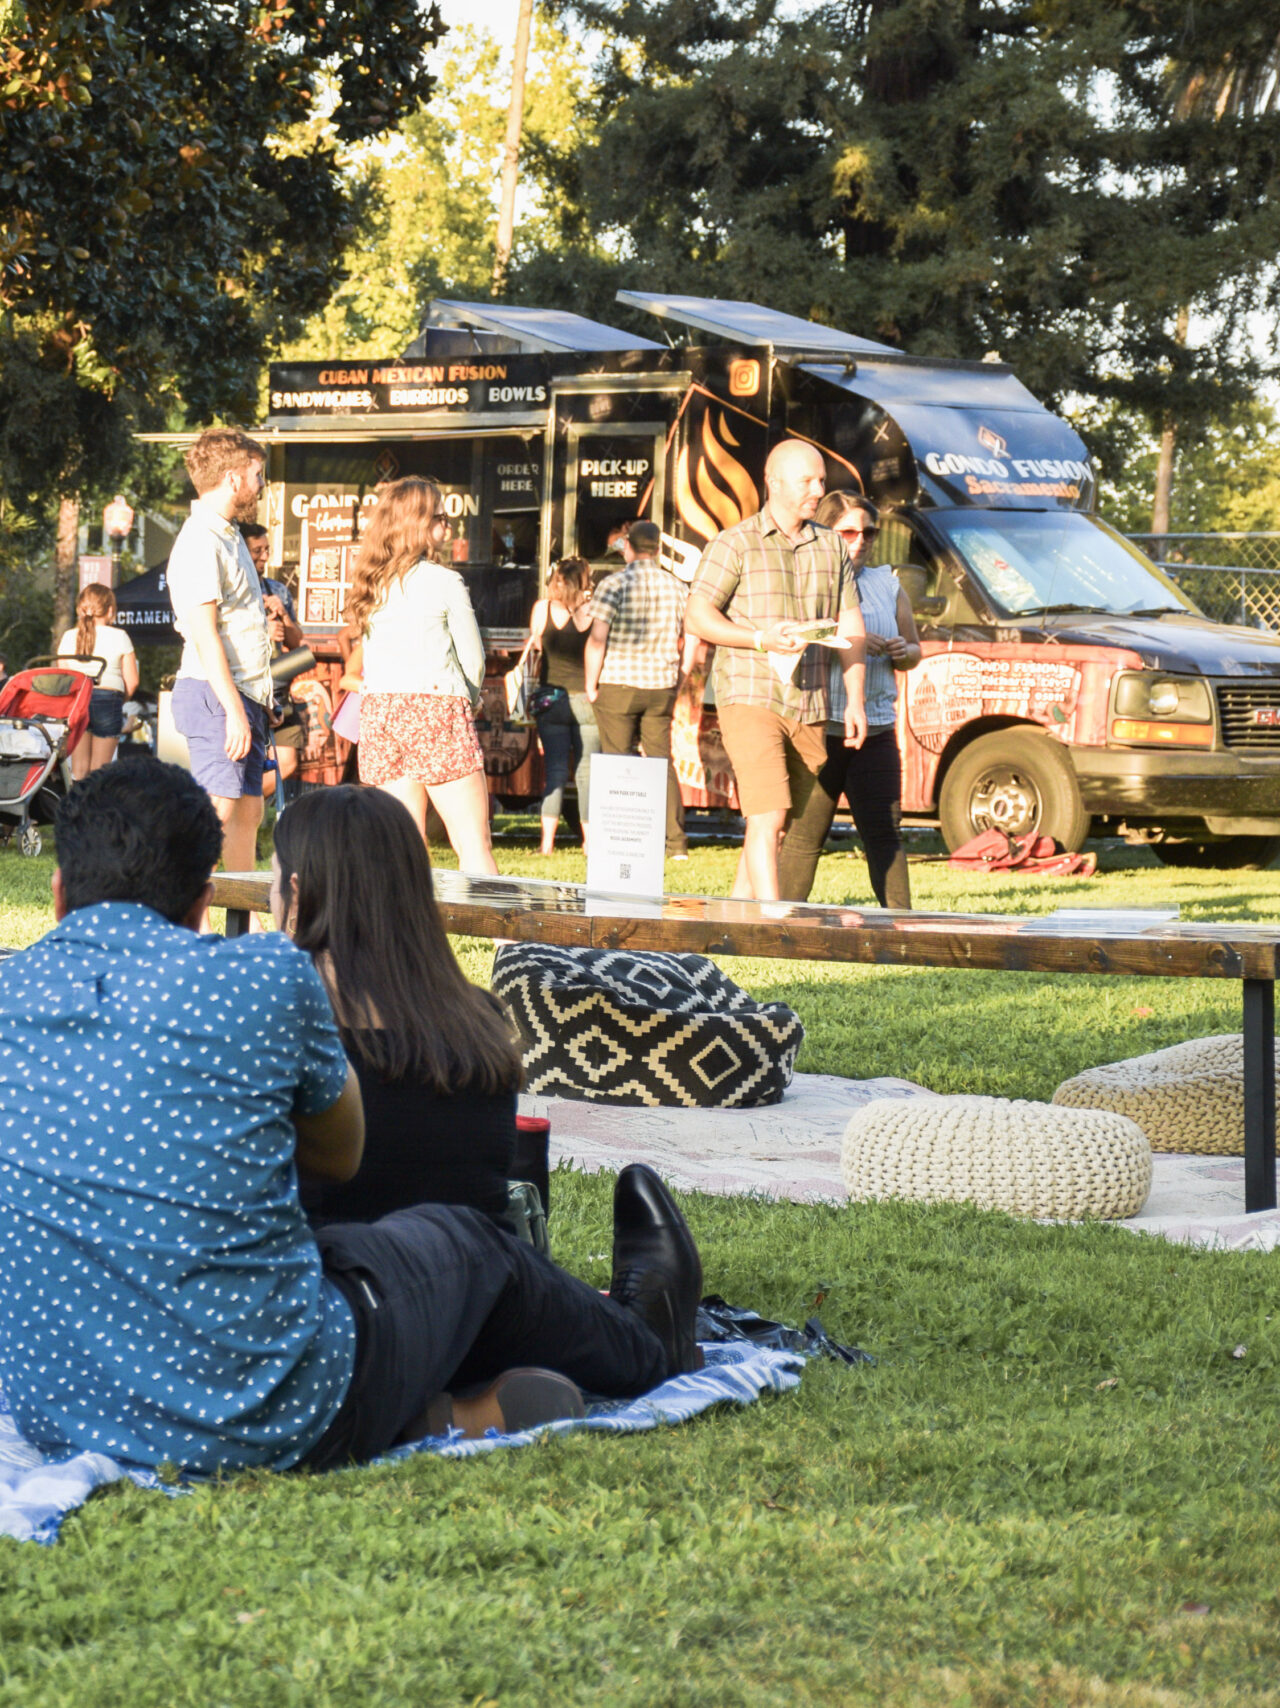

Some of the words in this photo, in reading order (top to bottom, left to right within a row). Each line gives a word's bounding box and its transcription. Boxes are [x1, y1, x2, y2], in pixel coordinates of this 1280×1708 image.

[319, 369, 368, 386] CUBAN
[372, 366, 445, 384] MEXICAN
[448, 365, 507, 382] FUSION
[271, 389, 372, 409] SANDWICHES
[389, 387, 469, 406] BURRITOS
[488, 385, 547, 403] BOWLS
[497, 462, 539, 476] ORDER
[580, 459, 649, 477] PICK-UP
[925, 452, 1009, 479] GONDO
[1011, 458, 1095, 483] FUSION
[500, 479, 534, 492] HERE
[590, 481, 638, 498] HERE
[964, 475, 1081, 499] Sacramento
[966, 661, 1010, 673] GONDO
